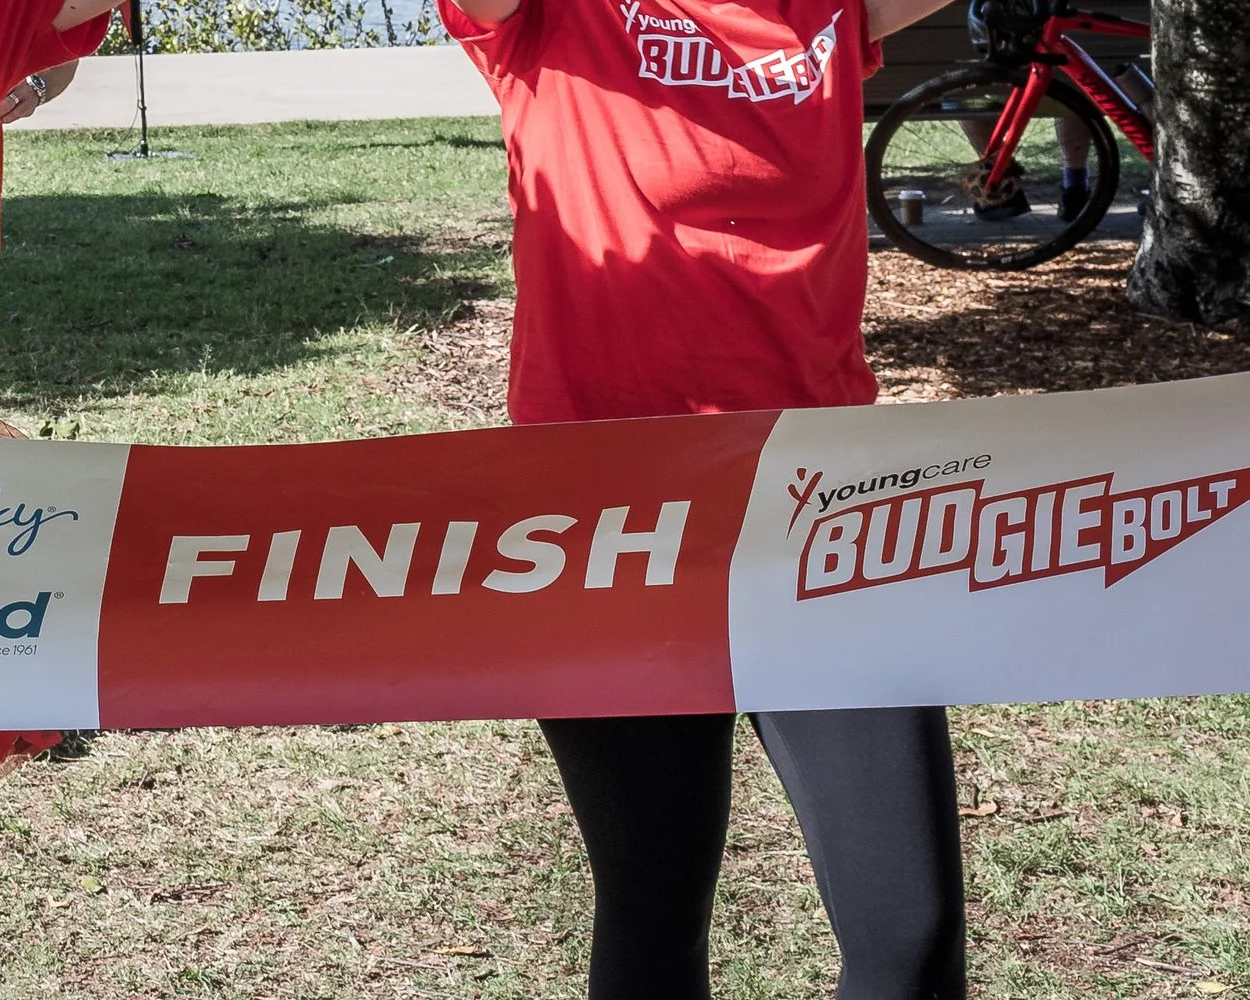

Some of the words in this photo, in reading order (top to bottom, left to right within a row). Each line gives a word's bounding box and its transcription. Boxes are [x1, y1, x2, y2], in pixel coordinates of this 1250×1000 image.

[637, 12, 702, 34] young
[817, 452, 993, 513] youngcare
[158, 500, 692, 605] FINISH
[804, 480, 1109, 591] BUDGIE
[1110, 478, 1237, 566] BOLT
[12, 644, 38, 656] 1961
